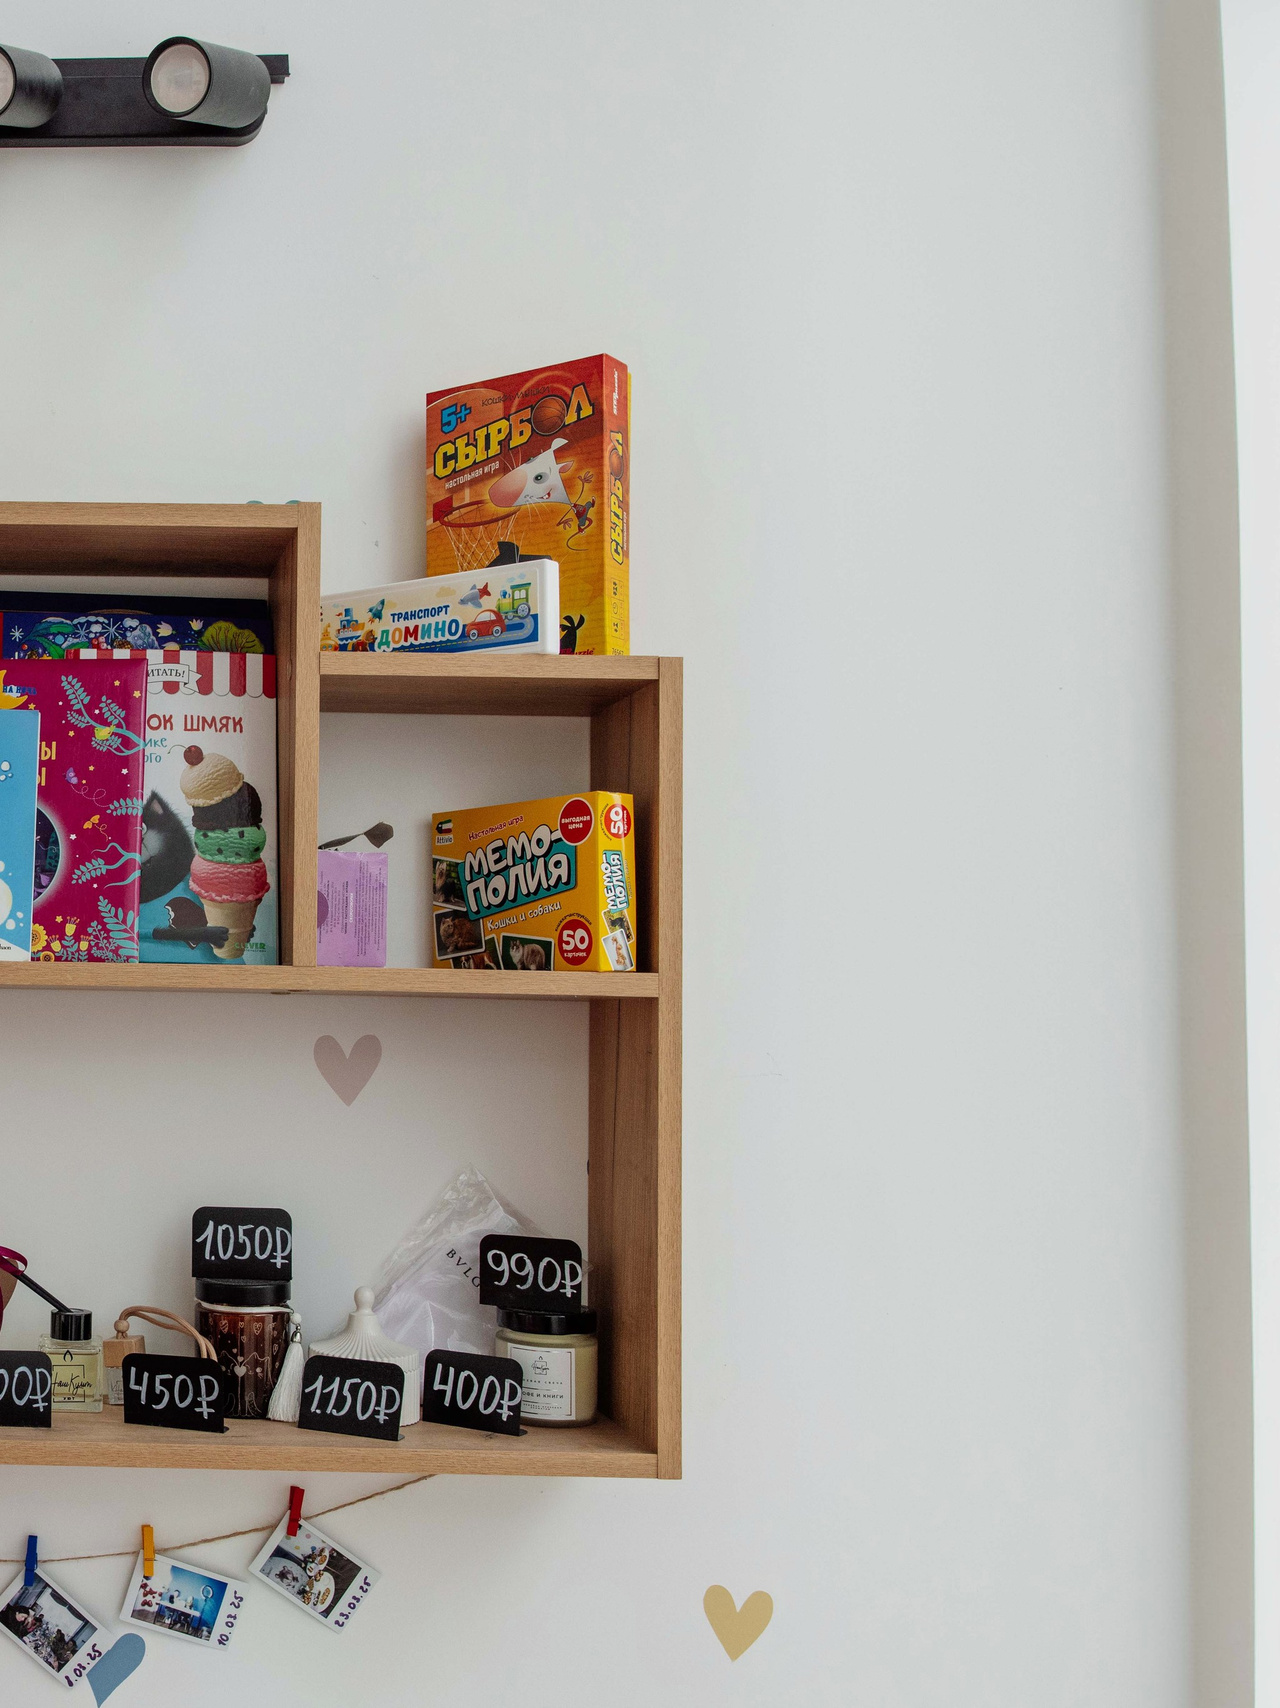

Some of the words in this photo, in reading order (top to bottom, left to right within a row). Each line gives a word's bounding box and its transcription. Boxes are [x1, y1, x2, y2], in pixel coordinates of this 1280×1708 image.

[434, 382, 595, 480] СЫРБОЛ
[441, 402, 472, 434] 5+
[445, 468, 482, 490] настольная
[484, 461, 500, 475] игра
[390, 605, 450, 623] ТРАНСПОРТ
[377, 618, 461, 649] ДОМИНО
[148, 668, 185, 678] ИТАТЬ!
[2, 685, 14, 694] НА
[147, 713, 174, 731] ОК
[183, 714, 244, 733] ШМЯК
[145, 737, 168, 748] ике
[468, 821, 507, 841] Настольная
[508, 815, 524, 828] игра
[561, 815, 591, 824] выгодная
[568, 821, 583, 830] цена
[610, 806, 624, 835] 50
[466, 853, 569, 913] ПОЛИЯ
[610, 854, 627, 909] ПОЛИЯ
[487, 914, 518, 931] Кошки
[519, 912, 526, 922] и
[528, 901, 562, 919] собаки
[234, 942, 266, 950] CLEVER
[562, 928, 589, 951] 50
[446, 1248, 480, 1288] BVLG
[486, 1249, 582, 1298] 990₽
[129, 1366, 219, 1420] 450₽
[433, 1362, 522, 1421] 400₽
[334, 1575, 371, 1628] 23.03.25
